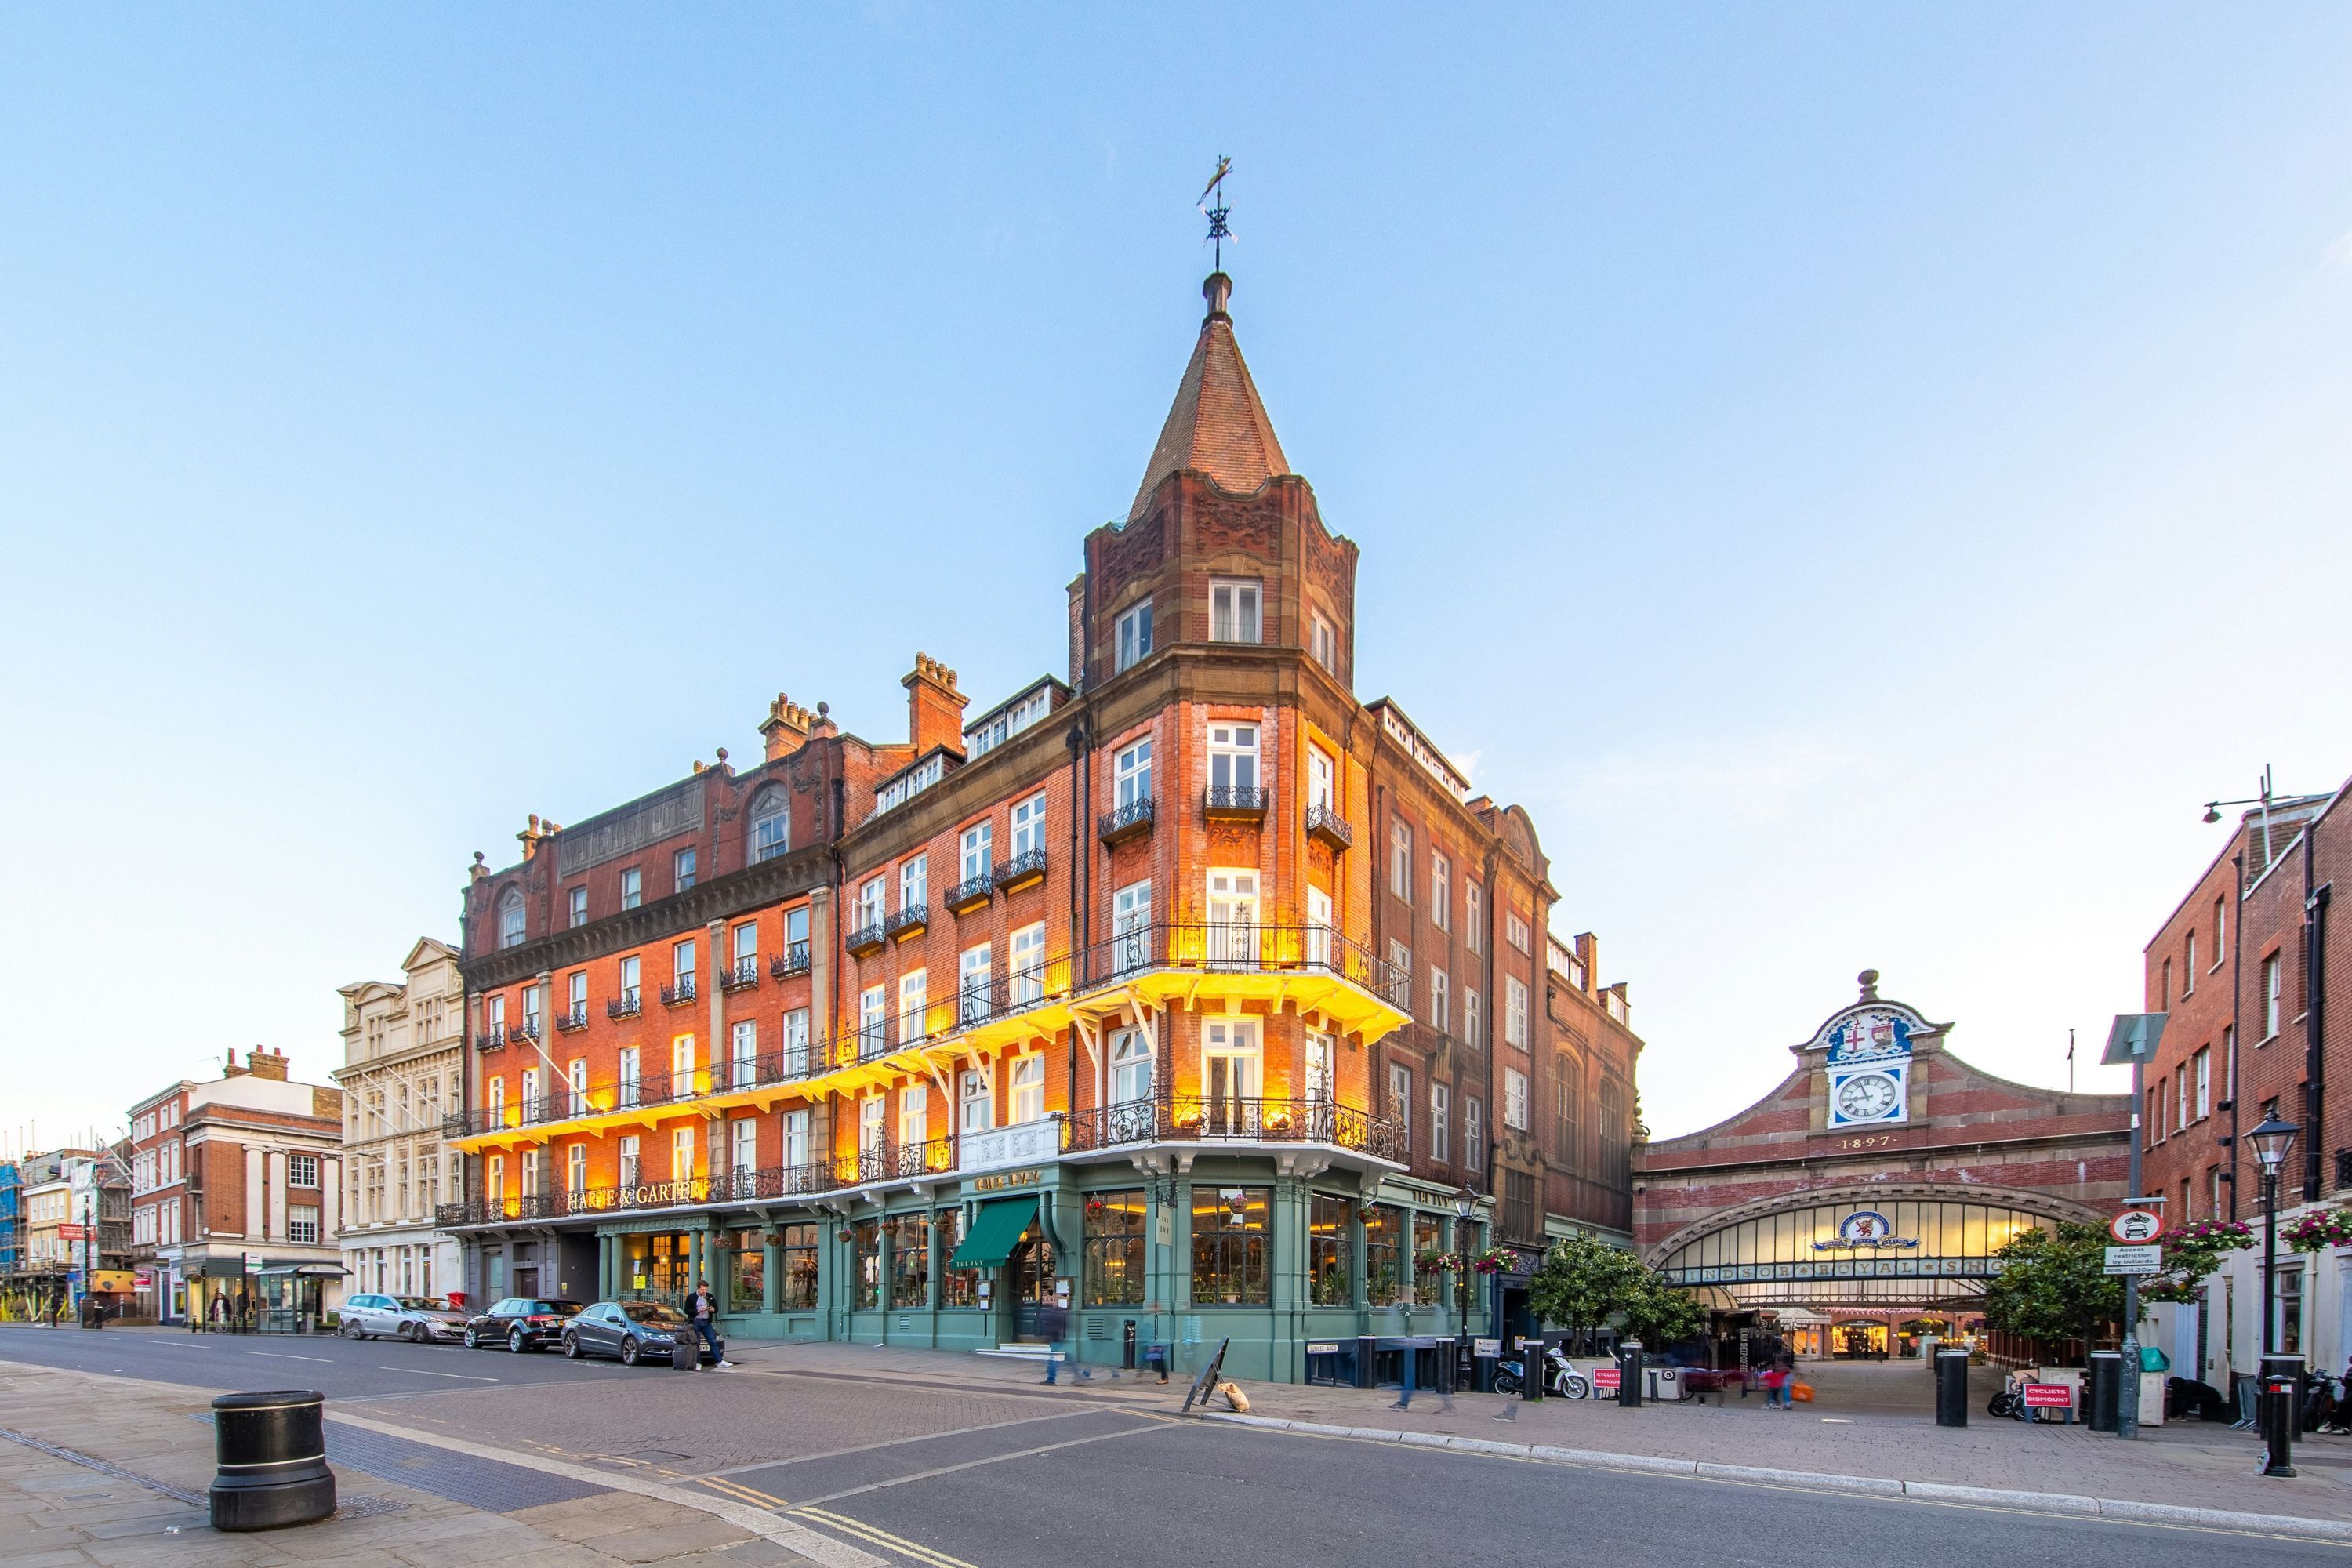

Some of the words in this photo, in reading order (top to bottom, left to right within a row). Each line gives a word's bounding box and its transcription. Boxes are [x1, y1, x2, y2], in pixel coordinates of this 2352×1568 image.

[562, 831, 606, 867] WHITE
[610, 814, 647, 851] HART
[652, 793, 699, 835] HOTEL
[973, 1174, 1004, 1191] THE
[1008, 1170, 1041, 1186] IVY
[619, 1189, 632, 1205] &
[1412, 1191, 1431, 1204] THE
[1432, 1193, 1450, 1207] IVY
[1671, 1265, 1789, 1281] WINDSOR
[1819, 1262, 1912, 1275] ROYAL
